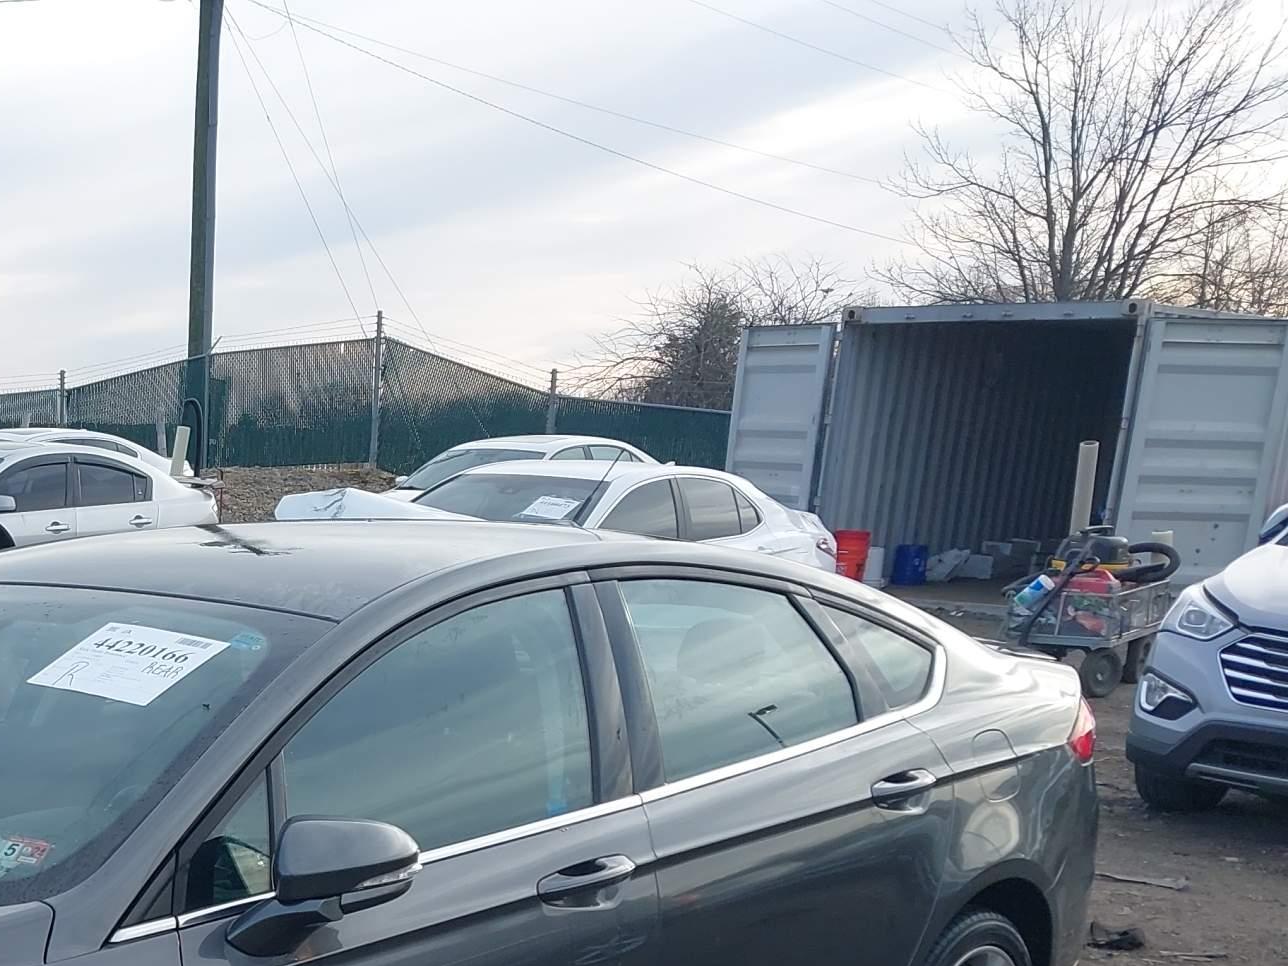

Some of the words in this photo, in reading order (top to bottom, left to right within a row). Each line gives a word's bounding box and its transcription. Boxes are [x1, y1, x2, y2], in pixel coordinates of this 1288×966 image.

[93, 637, 195, 663] 44220166
[141, 661, 184, 680] REAR
[3, 843, 20, 857] 5
